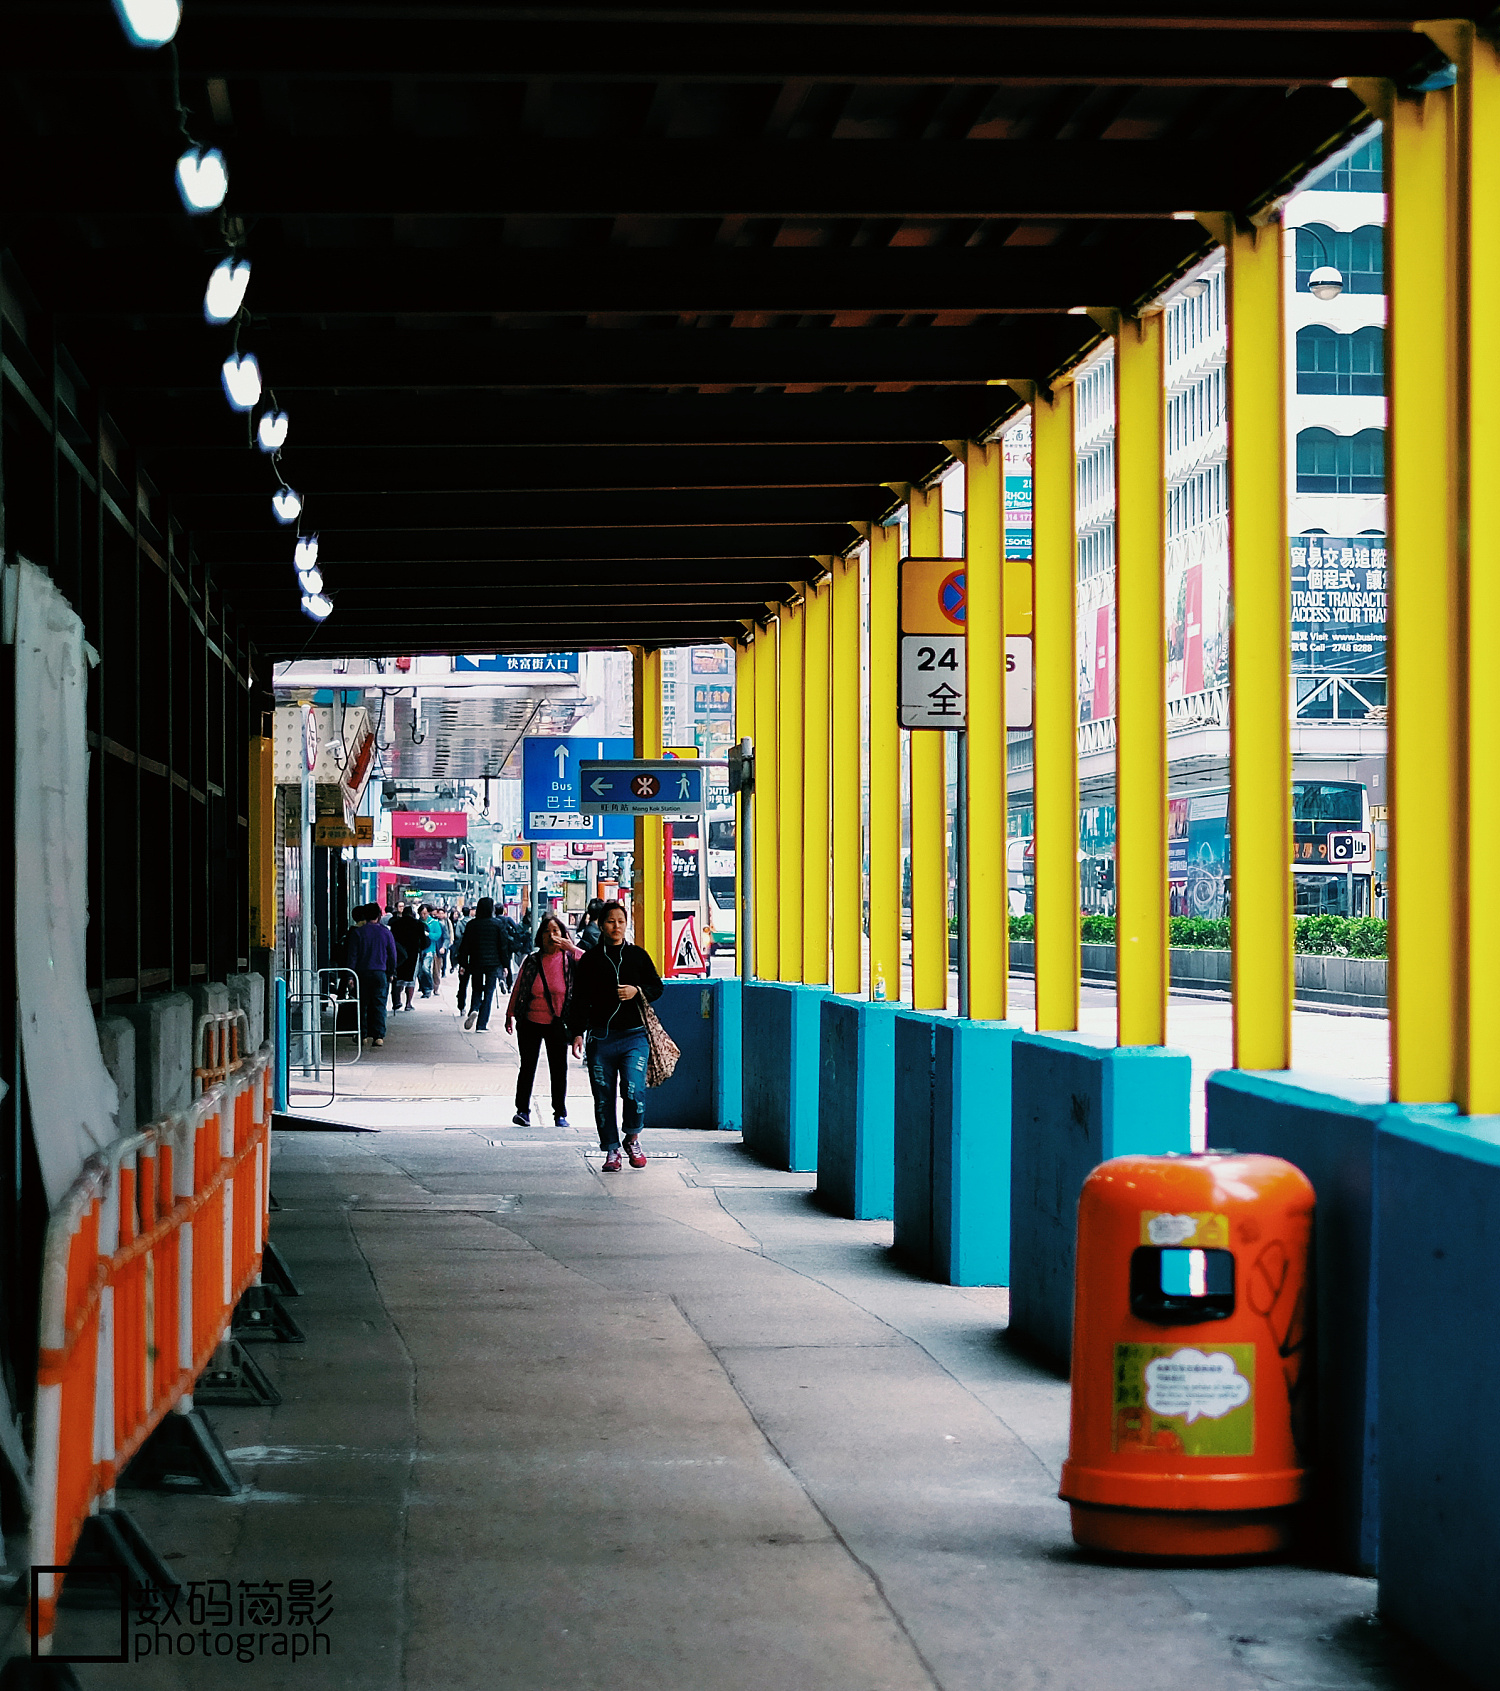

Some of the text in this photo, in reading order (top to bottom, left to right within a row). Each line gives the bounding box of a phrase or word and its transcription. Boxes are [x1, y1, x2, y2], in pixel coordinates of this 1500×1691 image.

[1291, 591, 1326, 607] TRADE
[1291, 607, 1331, 623] ACCESS
[1332, 607, 1361, 623] YOUR
[1309, 632, 1329, 641] Visit
[1309, 643, 1326, 652] Call
[917, 647, 959, 672] 24
[927, 682, 962, 716] 全
[552, 781, 573, 791] Bus
[547, 795, 576, 809] 巴士
[601, 803, 629, 811] 旺角站
[582, 815, 591, 827] 8
